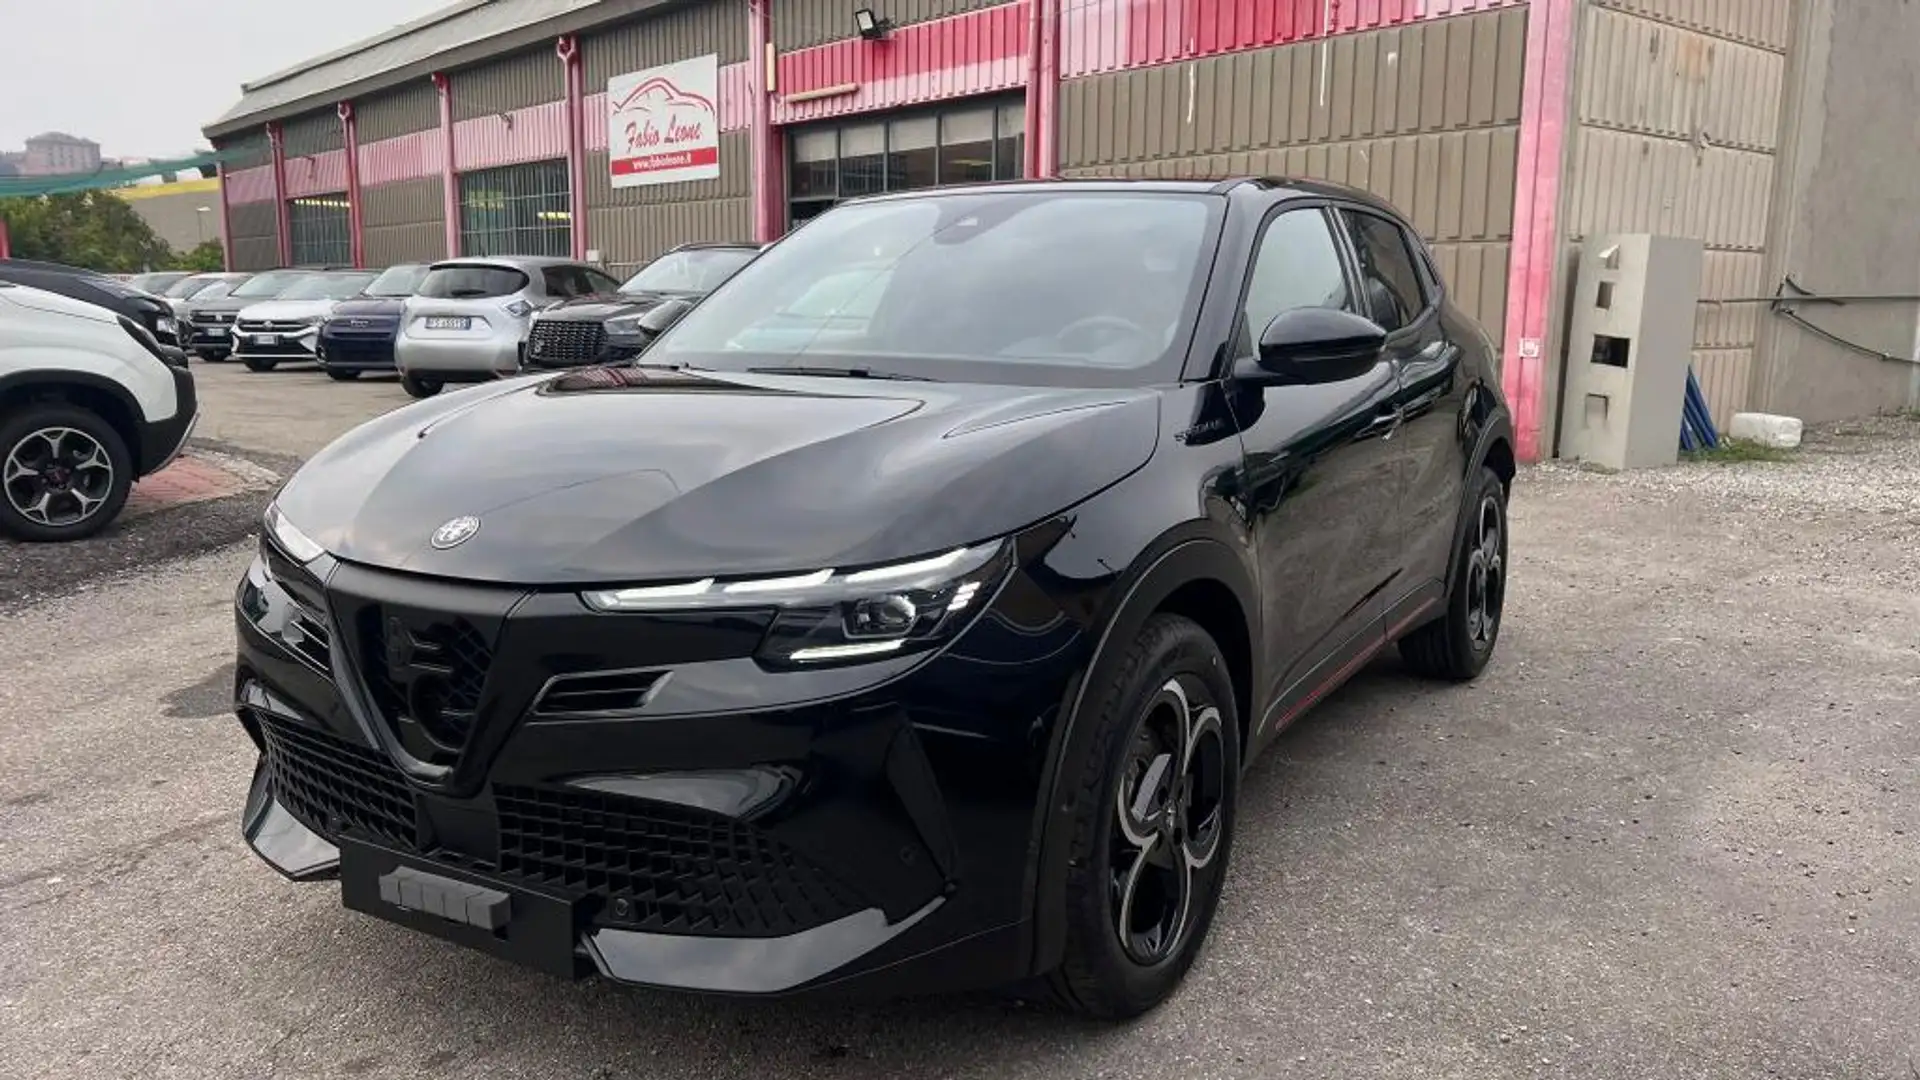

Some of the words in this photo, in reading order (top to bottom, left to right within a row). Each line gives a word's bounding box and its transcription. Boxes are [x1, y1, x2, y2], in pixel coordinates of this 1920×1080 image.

[625, 120, 660, 153] Fabio
[664, 114, 701, 143] Leone
[632, 152, 692, 171] www.fabioleone.it
